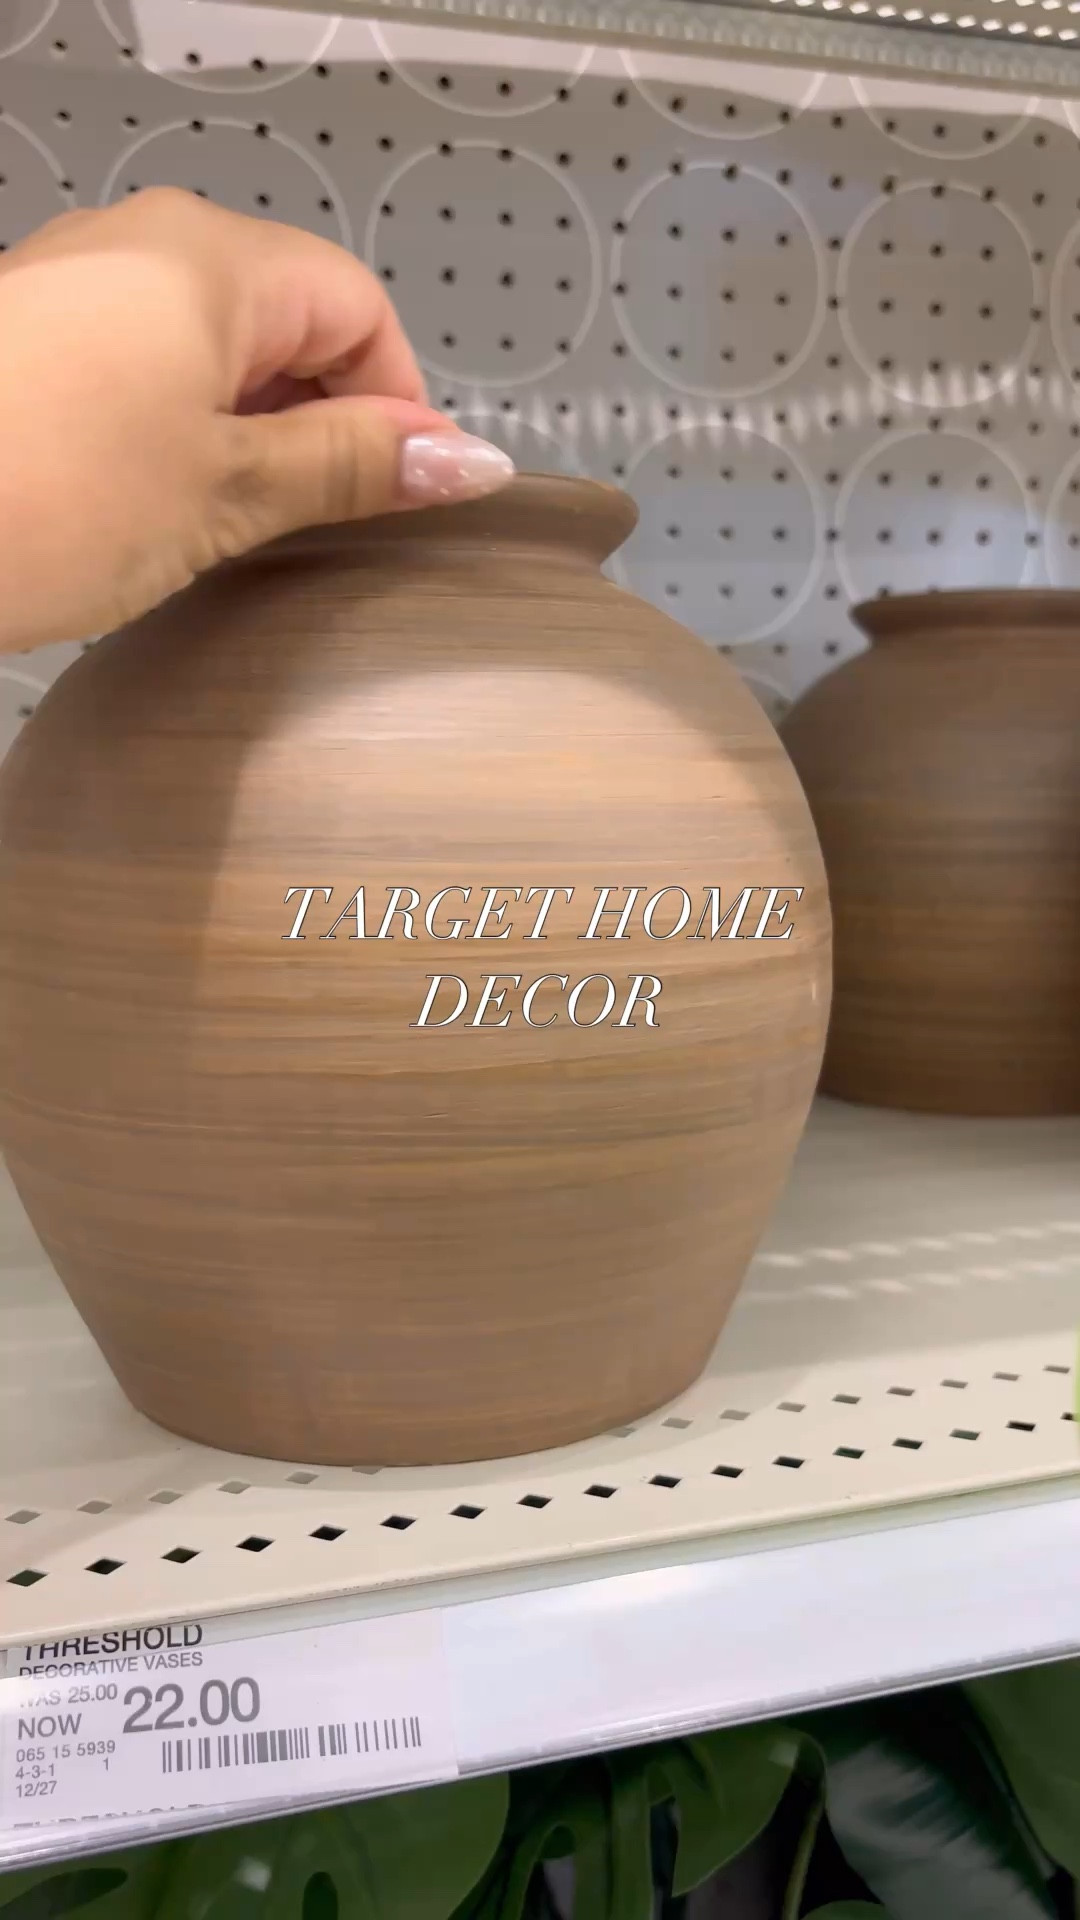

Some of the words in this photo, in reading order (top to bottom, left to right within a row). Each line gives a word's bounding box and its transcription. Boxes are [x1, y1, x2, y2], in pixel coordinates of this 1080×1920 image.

[25, 1624, 203, 1661] THRESHOLD
[19, 1656, 139, 1680] DECORATIVE
[143, 1651, 203, 1671] VASES
[67, 1683, 118, 1704] 25.00
[18, 1713, 82, 1740] NOW
[122, 1677, 260, 1734] 22.00
[16, 1747, 45, 1762] 065
[52, 1744, 71, 1759] 15
[76, 1740, 116, 1757] 5939
[15, 1763, 55, 1779] 4-3-1
[103, 1757, 109, 1771] 1
[15, 1780, 57, 1798] 12/27
